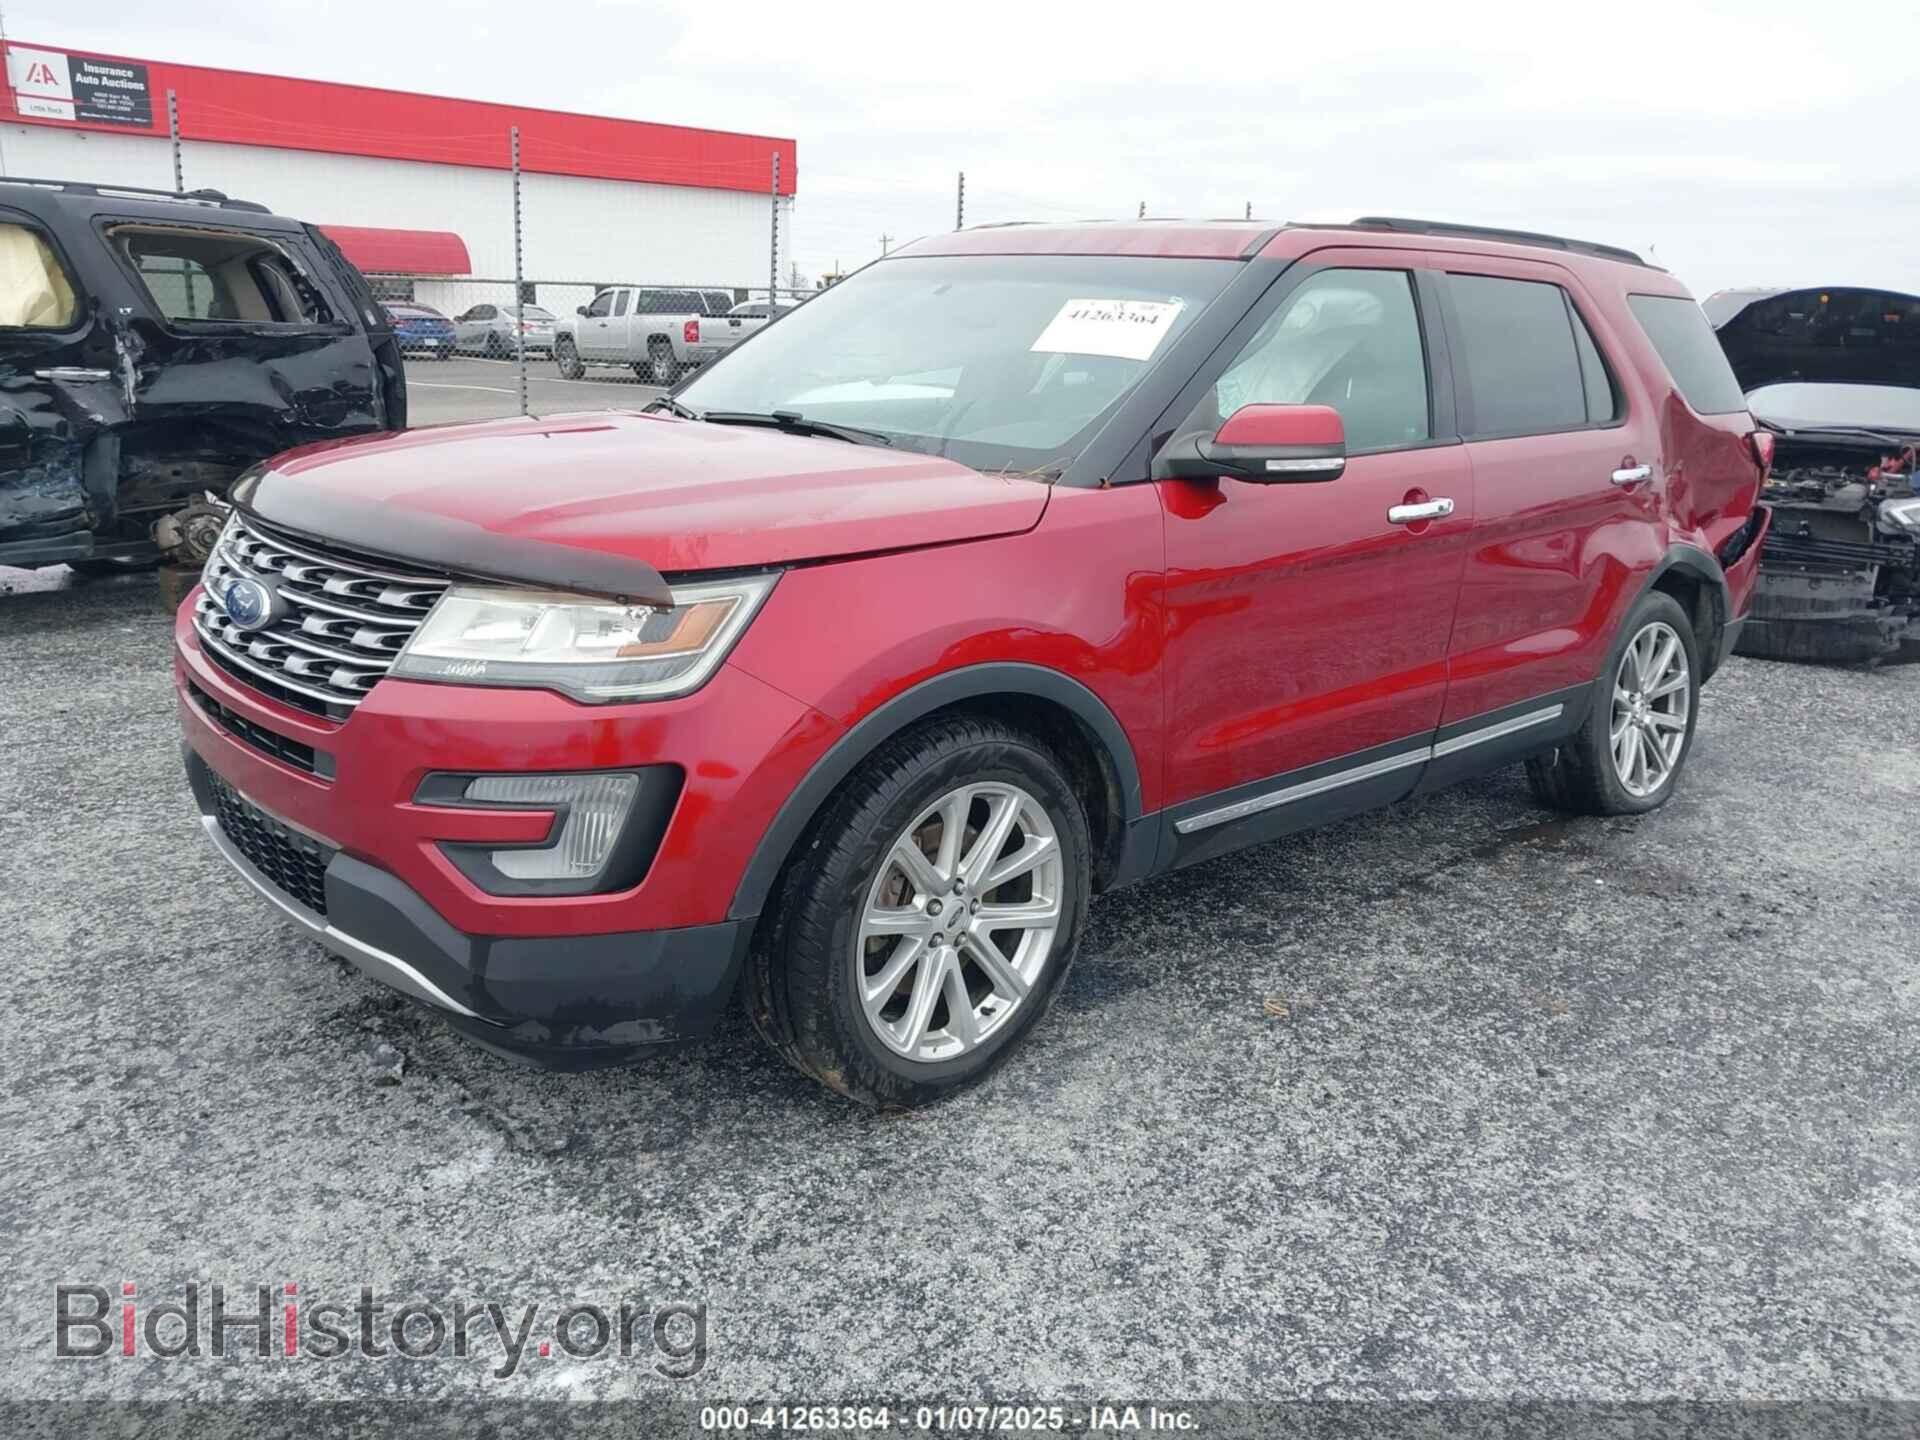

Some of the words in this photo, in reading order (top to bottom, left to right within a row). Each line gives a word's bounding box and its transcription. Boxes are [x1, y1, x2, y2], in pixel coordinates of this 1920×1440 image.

[83, 62, 134, 78] Insurance
[75, 73, 99, 86] Auto
[101, 76, 145, 91] Auctions
